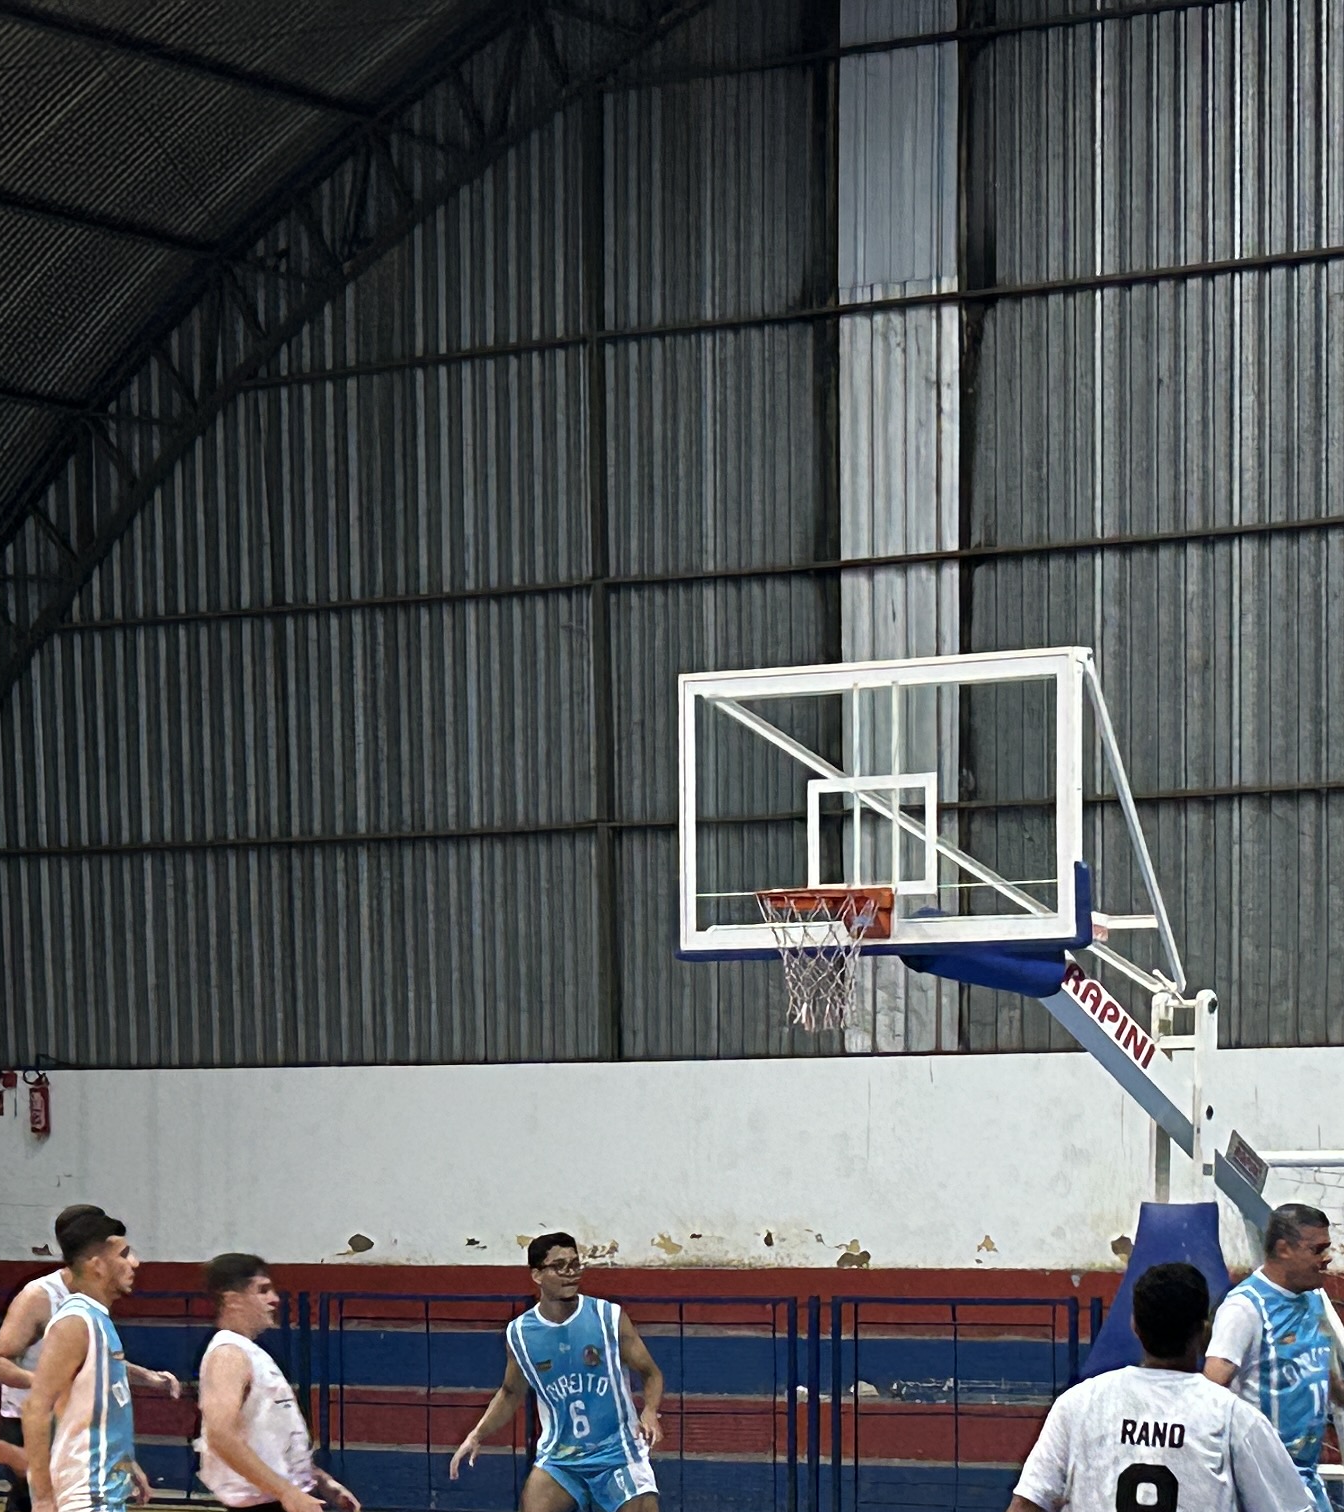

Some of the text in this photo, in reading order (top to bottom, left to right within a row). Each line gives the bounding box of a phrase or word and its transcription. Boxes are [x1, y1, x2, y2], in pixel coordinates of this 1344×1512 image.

[1063, 963, 1156, 1070] RAPINI
[569, 1400, 590, 1438] 6
[1120, 1419, 1185, 1449] RANO
